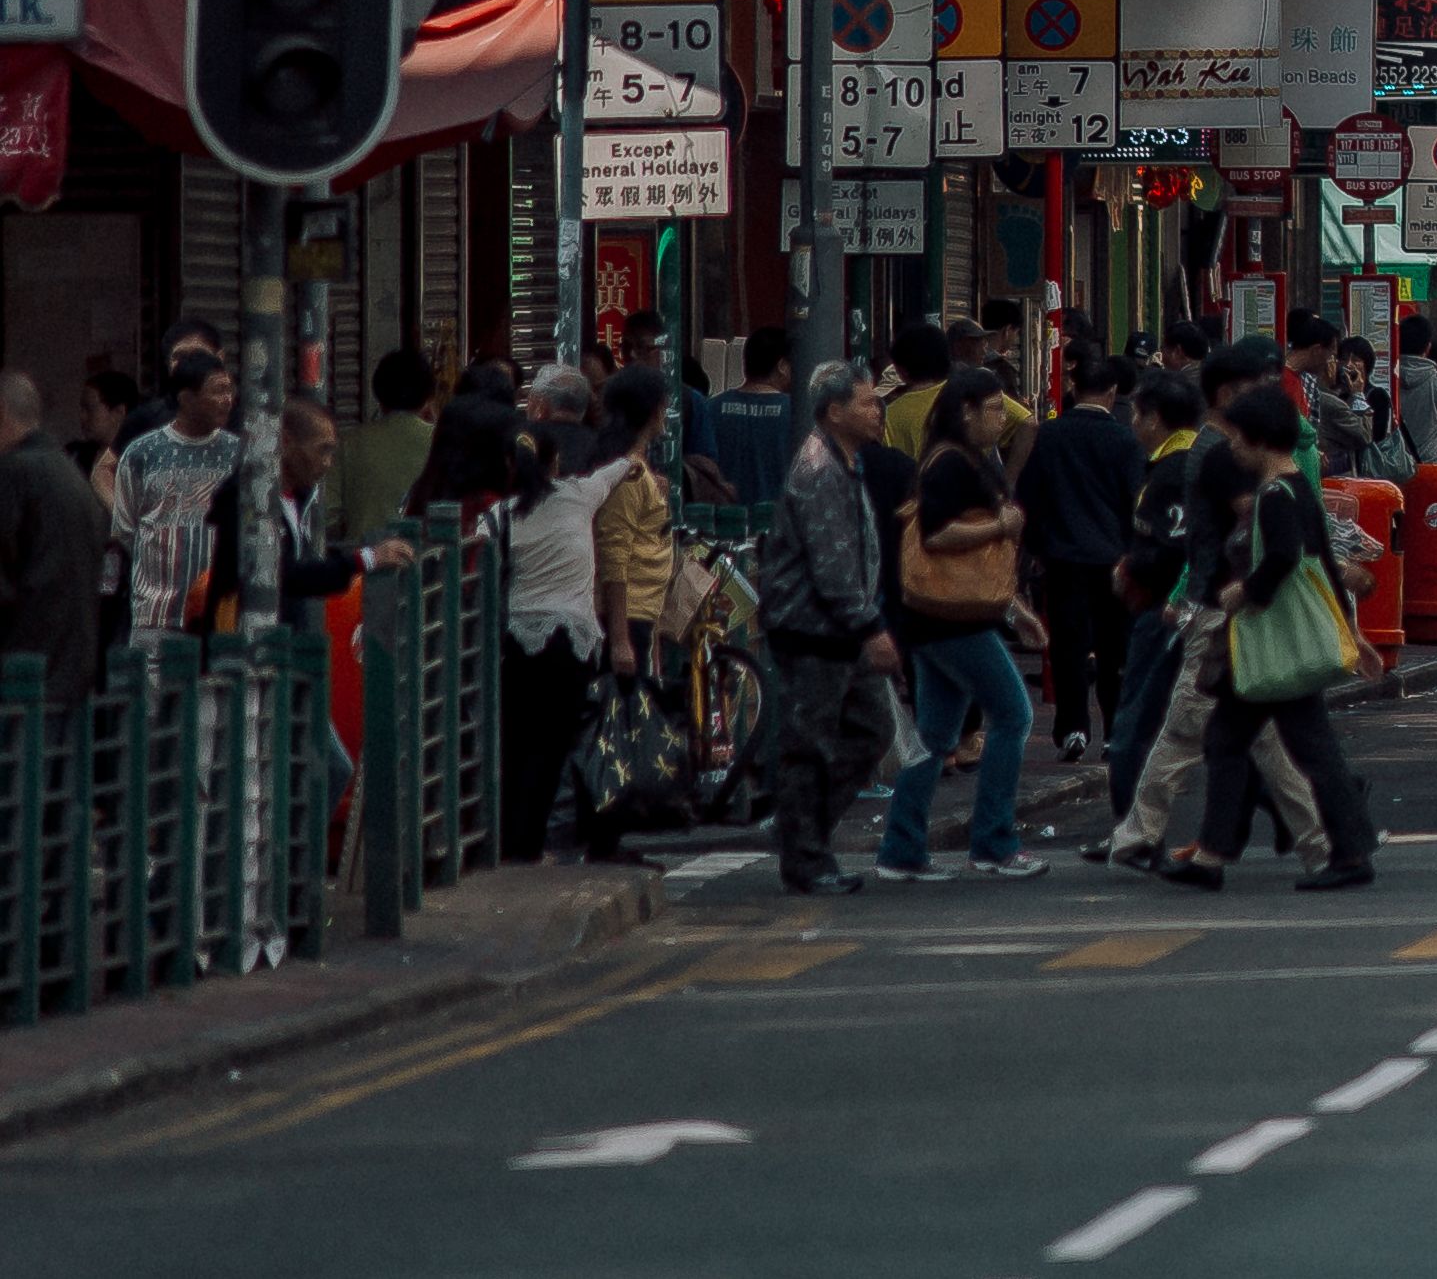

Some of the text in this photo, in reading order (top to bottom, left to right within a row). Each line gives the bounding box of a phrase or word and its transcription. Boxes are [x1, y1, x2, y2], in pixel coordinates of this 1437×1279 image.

[1016, 62, 1041, 76] am
[1121, 60, 1252, 88] Wah Kee
[1308, 68, 1357, 85] Beads
[1068, 66, 1091, 96] 7
[1008, 109, 1064, 127] idnight
[1071, 113, 1110, 145] 12
[610, 142, 675, 159] Except
[582, 160, 719, 180] eneral Holidays
[1228, 169, 1282, 182] BUS STOP
[1345, 180, 1395, 191] BUS STOP
